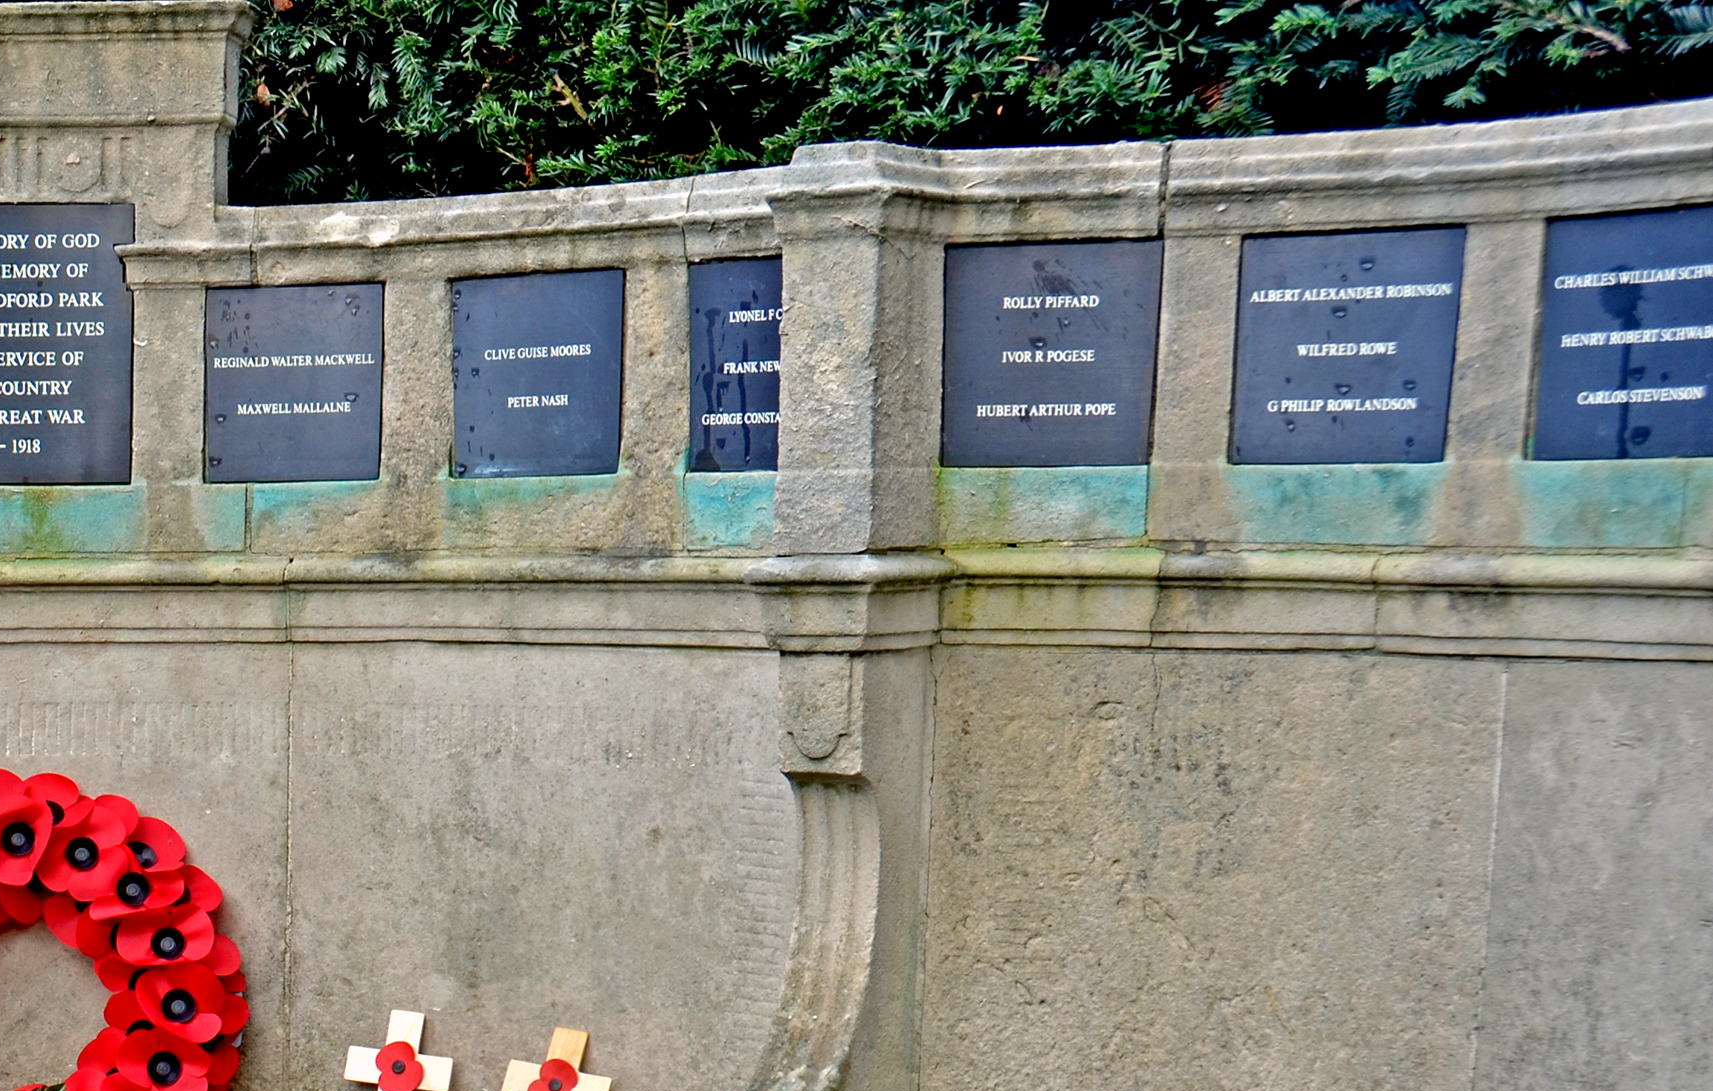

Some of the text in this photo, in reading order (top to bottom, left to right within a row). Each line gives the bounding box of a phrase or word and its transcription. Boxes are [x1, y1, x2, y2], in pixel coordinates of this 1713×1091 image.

[34, 234, 57, 249] OF
[61, 233, 100, 249] GOD
[66, 263, 89, 278] OF
[1554, 272, 1617, 290] CHARLES
[1618, 267, 1678, 285] WILLIAM
[58, 292, 104, 308] PARK
[1249, 283, 1452, 303] ALBERT ALEXANDER ROBINSON
[1002, 295, 1100, 309] ROLLY PIFFARD
[729, 309, 768, 323] LYONEL
[768, 308, 775, 321] F
[56, 321, 105, 337] LIVES
[1560, 332, 1609, 348] HENRY
[1608, 328, 1660, 345] ROBERT
[484, 343, 592, 361] CLIVE GUISE MOORES
[1001, 349, 1095, 363] IVOR R POGESE
[1296, 341, 1397, 357] WILFRED ROWE
[61, 351, 84, 366] OF
[213, 353, 375, 369] REGINALD WALTER MACKWELL
[723, 361, 758, 375] FRANK
[507, 394, 569, 409] PETER NASH
[1576, 386, 1705, 405] CARLOS STEVENSON
[237, 403, 292, 415] MAXWELL
[976, 403, 1117, 417] HUBERT ARTHUR POPE
[1267, 397, 1417, 413] G PHILIP ROWLANDSON
[47, 409, 85, 424] WAR
[701, 412, 743, 426] GEORGE
[12, 438, 41, 454] 1918
